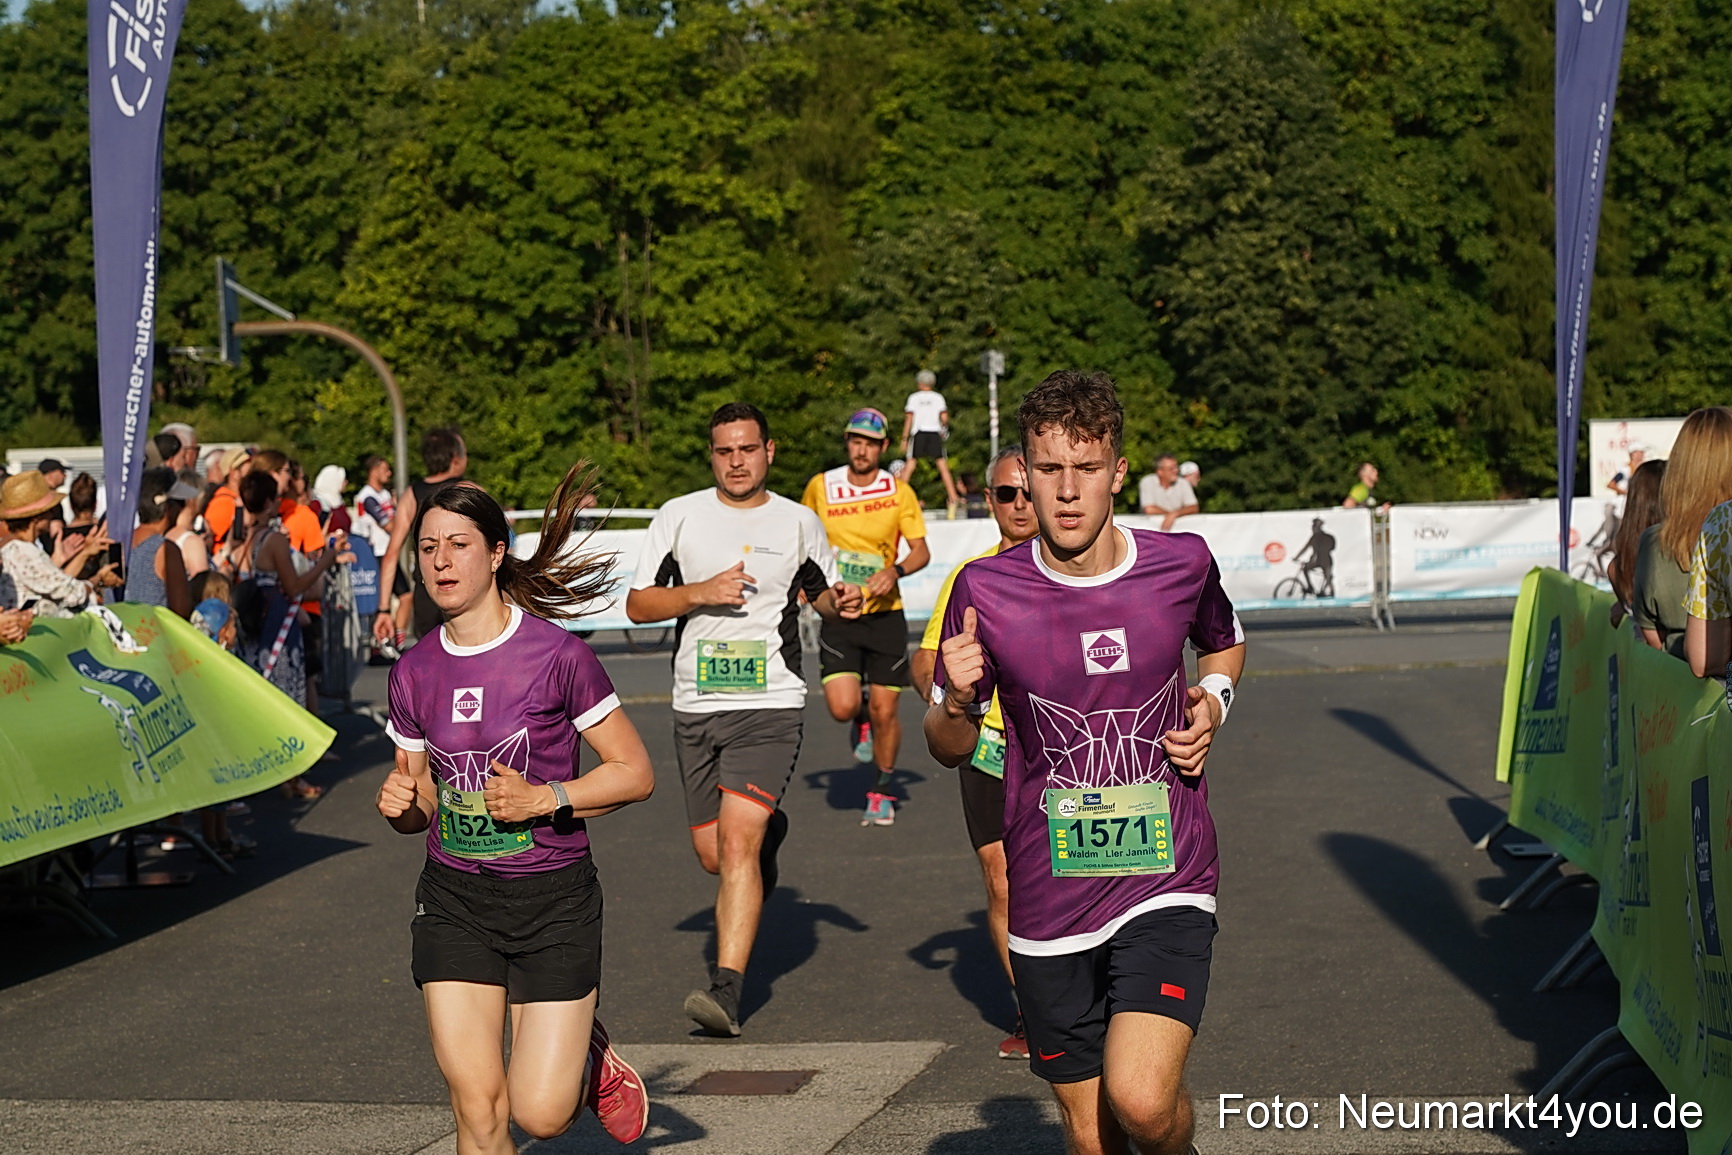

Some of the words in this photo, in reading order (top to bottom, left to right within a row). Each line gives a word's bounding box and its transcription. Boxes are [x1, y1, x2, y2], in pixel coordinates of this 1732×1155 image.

[827, 506, 859, 517] MAX
[864, 499, 899, 512] BÖGL
[1086, 646, 1125, 658] FUCHS
[708, 657, 756, 675] 1314
[454, 701, 481, 709] FUCHS
[1078, 802, 1116, 812] Firmenlauf
[441, 814, 449, 840] RUN
[1070, 815, 1148, 848] 1571
[456, 837, 481, 848] Meyer
[483, 837, 505, 847] Lisa
[1056, 829, 1069, 859] RUN
[1154, 818, 1169, 861] 2022
[1068, 849, 1099, 859] Waldm
[1126, 846, 1157, 857] Jannik
